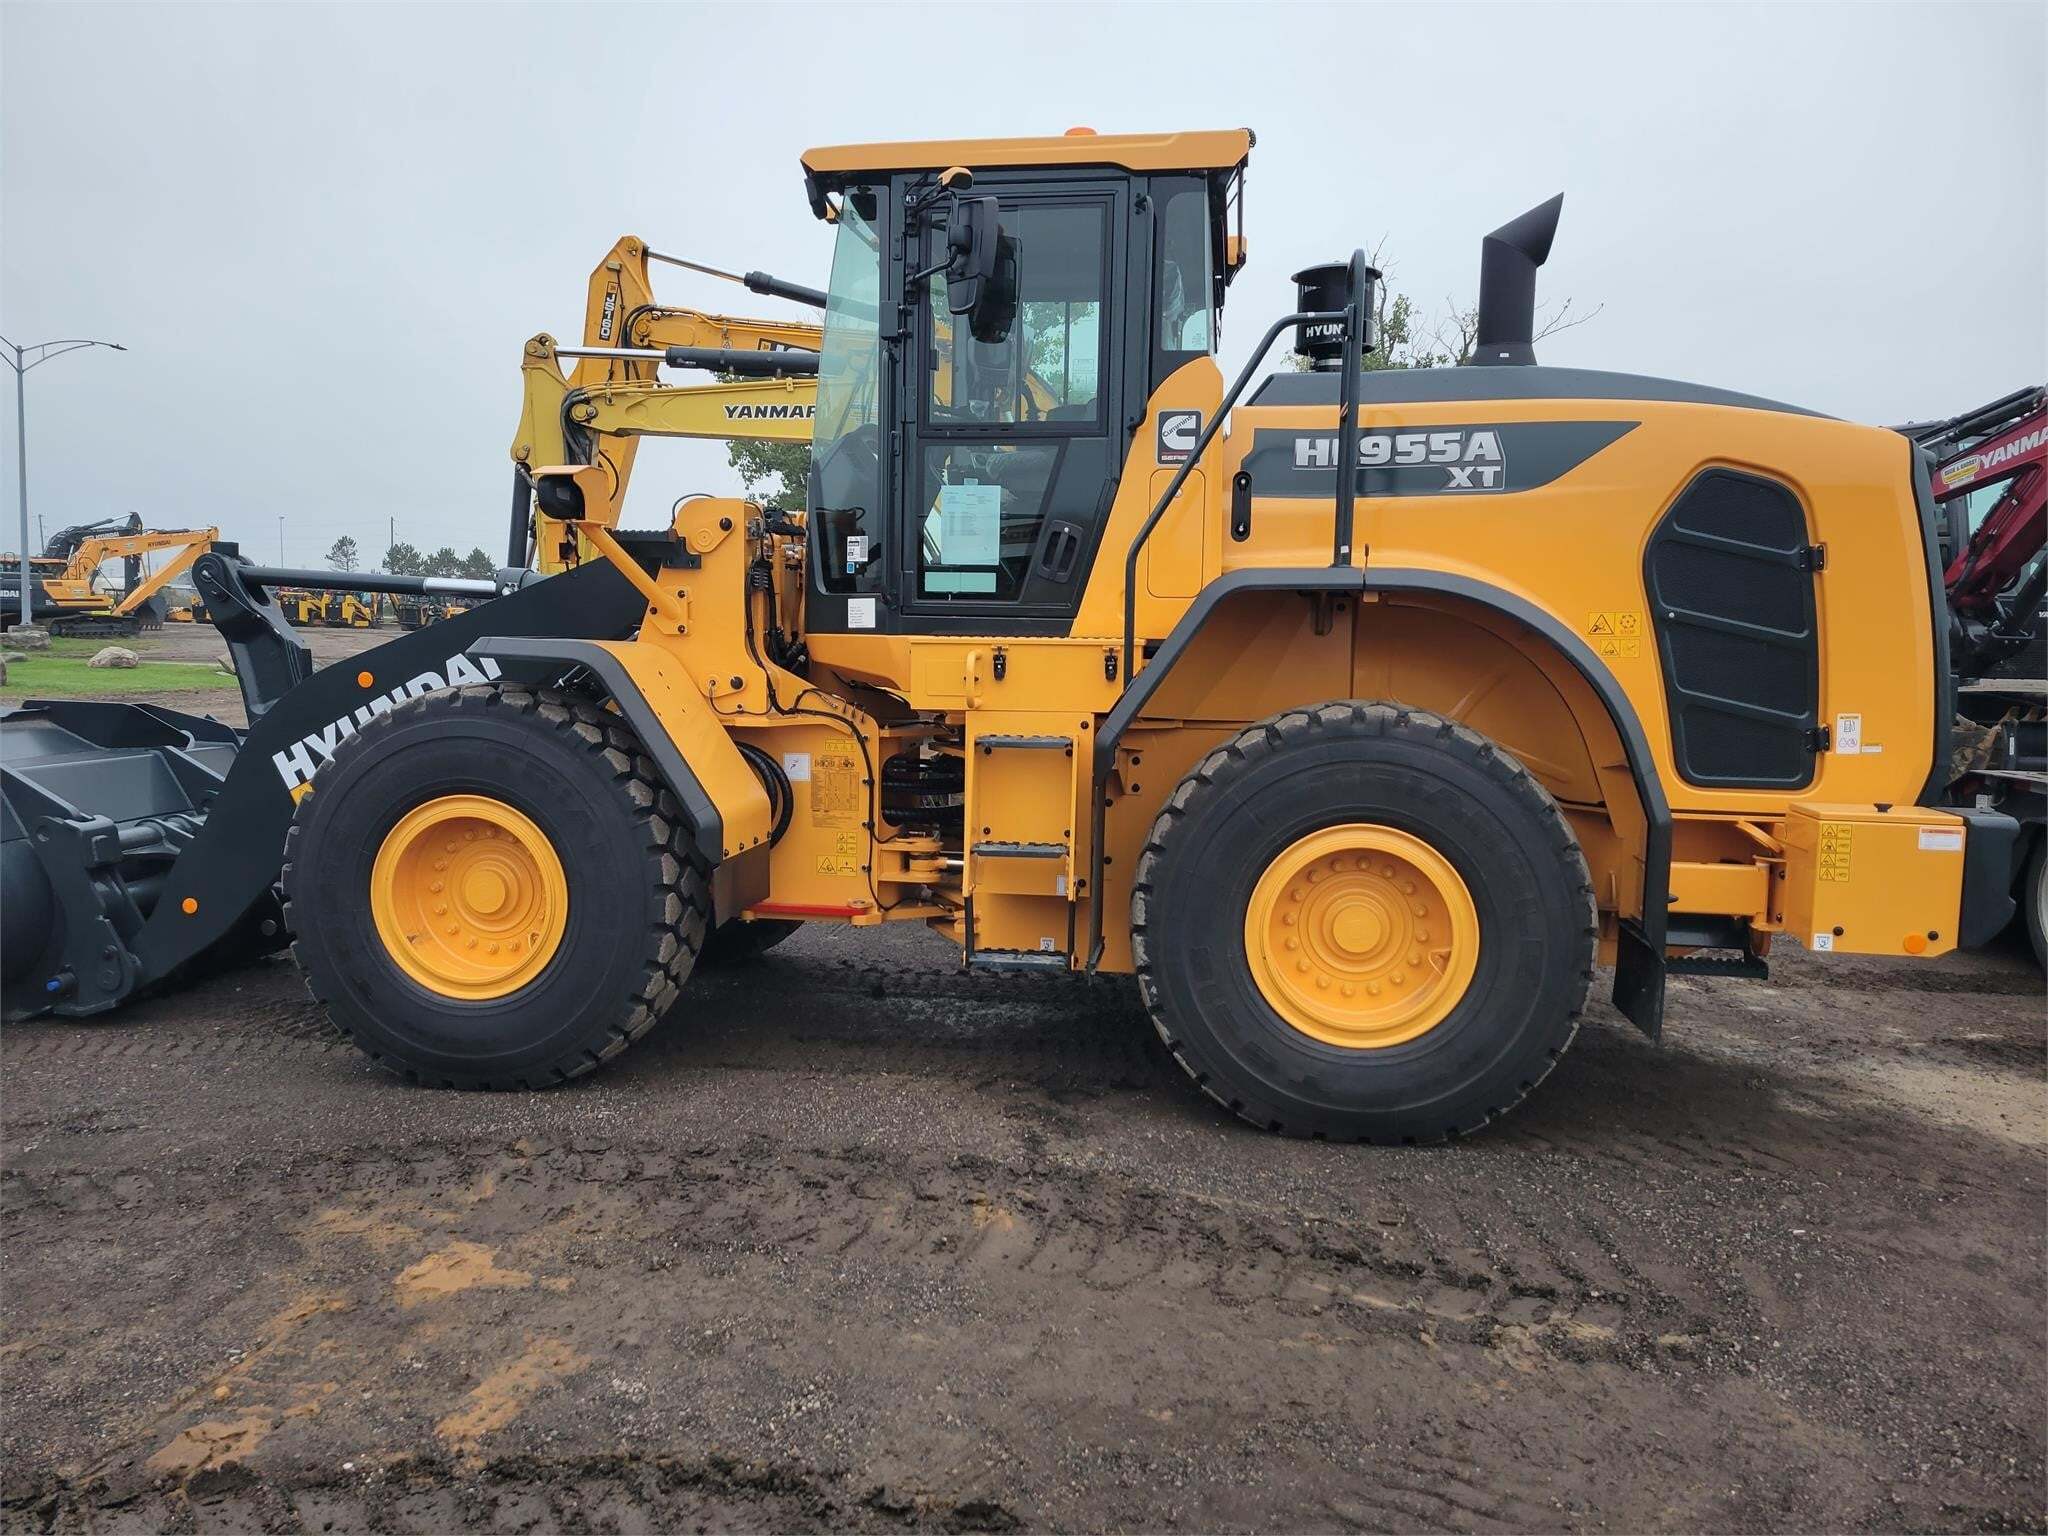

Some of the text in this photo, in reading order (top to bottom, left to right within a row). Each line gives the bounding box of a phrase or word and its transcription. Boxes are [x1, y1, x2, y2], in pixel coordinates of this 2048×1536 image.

[1305, 323, 1345, 338] HYUN
[1162, 415, 1193, 438] Cummins
[1295, 431, 1502, 466] H955A
[1447, 466, 1502, 488] XT
